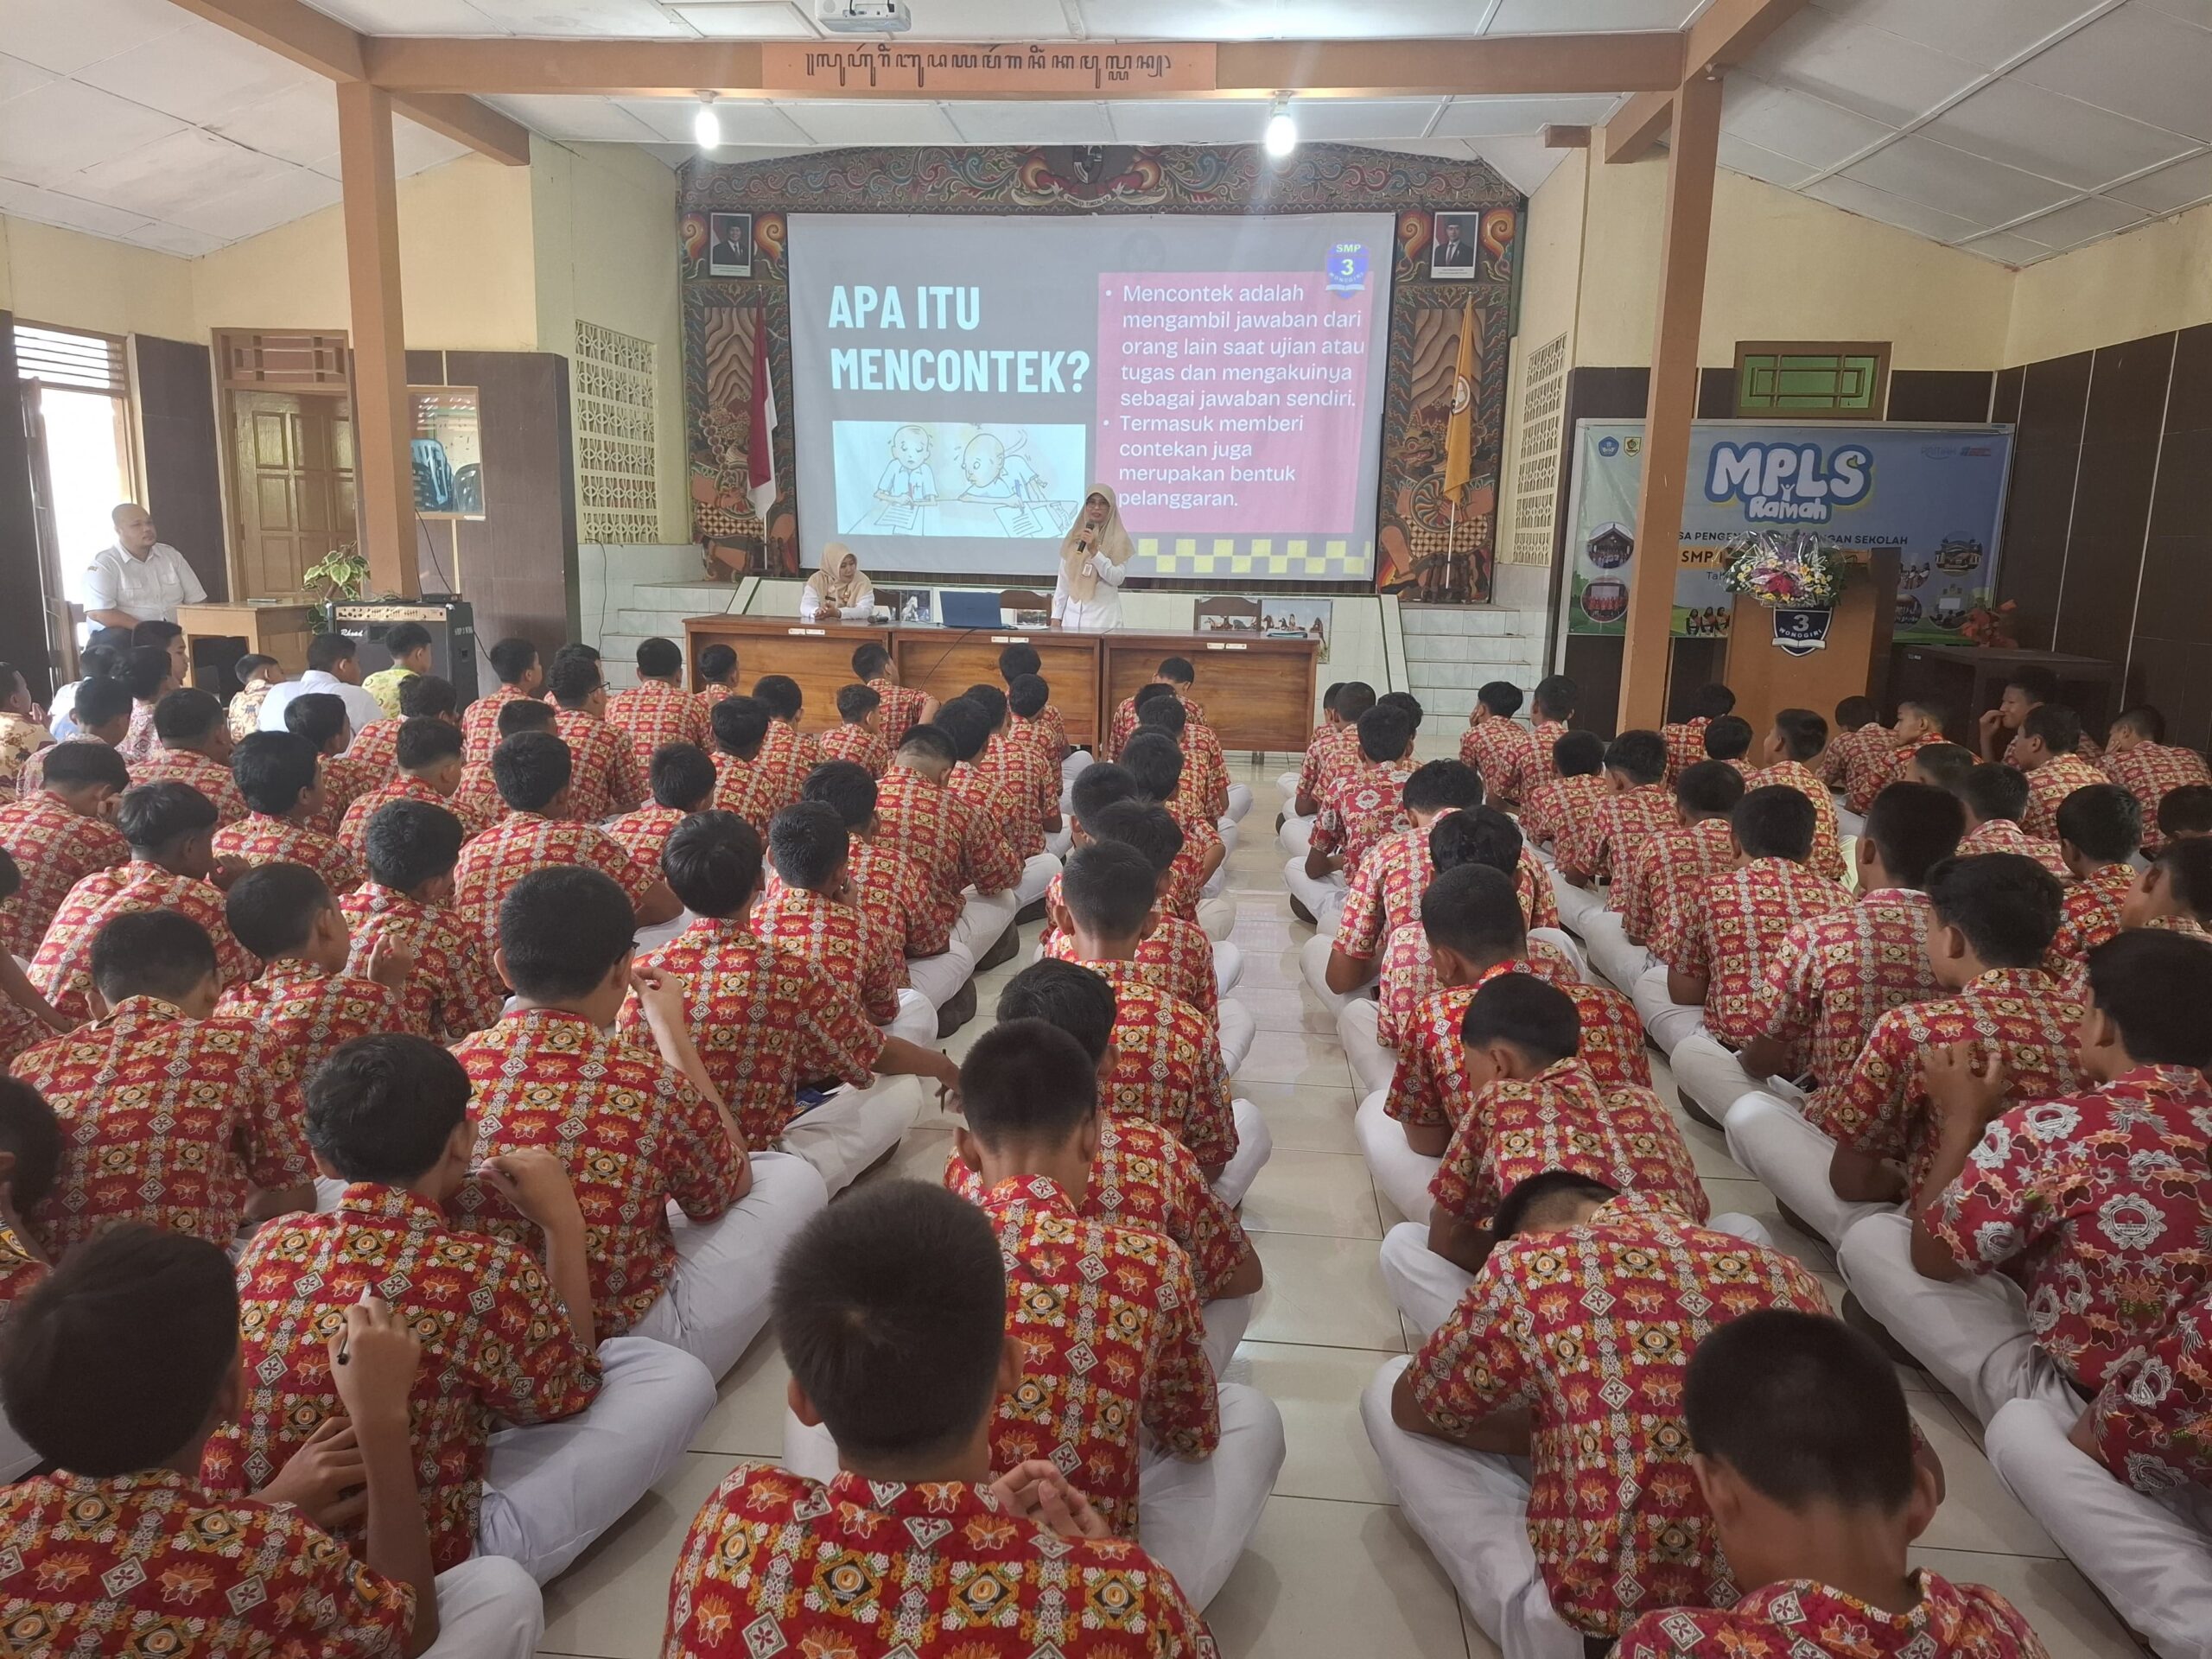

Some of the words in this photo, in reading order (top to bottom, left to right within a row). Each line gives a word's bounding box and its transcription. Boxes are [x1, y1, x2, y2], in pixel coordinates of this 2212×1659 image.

[1336, 244, 1362, 253] SMP
[1341, 258, 1354, 276] 3
[1124, 284, 1233, 302] Mencontek
[1240, 284, 1303, 301] adalah
[829, 285, 906, 328] APA
[918, 286, 980, 330] ITU
[1123, 311, 1230, 332] mengambil
[1234, 311, 1317, 332] jawaban
[1324, 310, 1361, 327] dari
[1122, 342, 1178, 358] orang
[1185, 339, 1217, 354] lain
[1224, 340, 1264, 354] saat
[1271, 338, 1315, 358] ujian
[1322, 340, 1363, 354] atau
[830, 348, 1090, 393] MENCONTEK?
[1122, 365, 1174, 384] tugas
[1181, 365, 1216, 380] dan
[1223, 364, 1351, 384] mengakuinya
[1121, 390, 1194, 410] sebagai
[1198, 391, 1280, 410] jawaban
[1287, 390, 1355, 406] sendiri.
[1120, 416, 1213, 431] Termasuk
[1220, 415, 1303, 431] memberi
[1120, 441, 1207, 456] contekan
[1211, 442, 1251, 460] juga
[1120, 466, 1224, 484] merupakan
[1231, 466, 1294, 481] bentuk
[1712, 448, 1866, 498] MPLS
[1119, 490, 1237, 509] pelanggaran.
[1749, 496, 1827, 519] Ramah
[1854, 536, 1908, 544] SEKOLAH
[1681, 550, 1713, 563] SMP
[1779, 626, 1822, 638] WONOGIRI
[1792, 614, 1809, 632] 3
